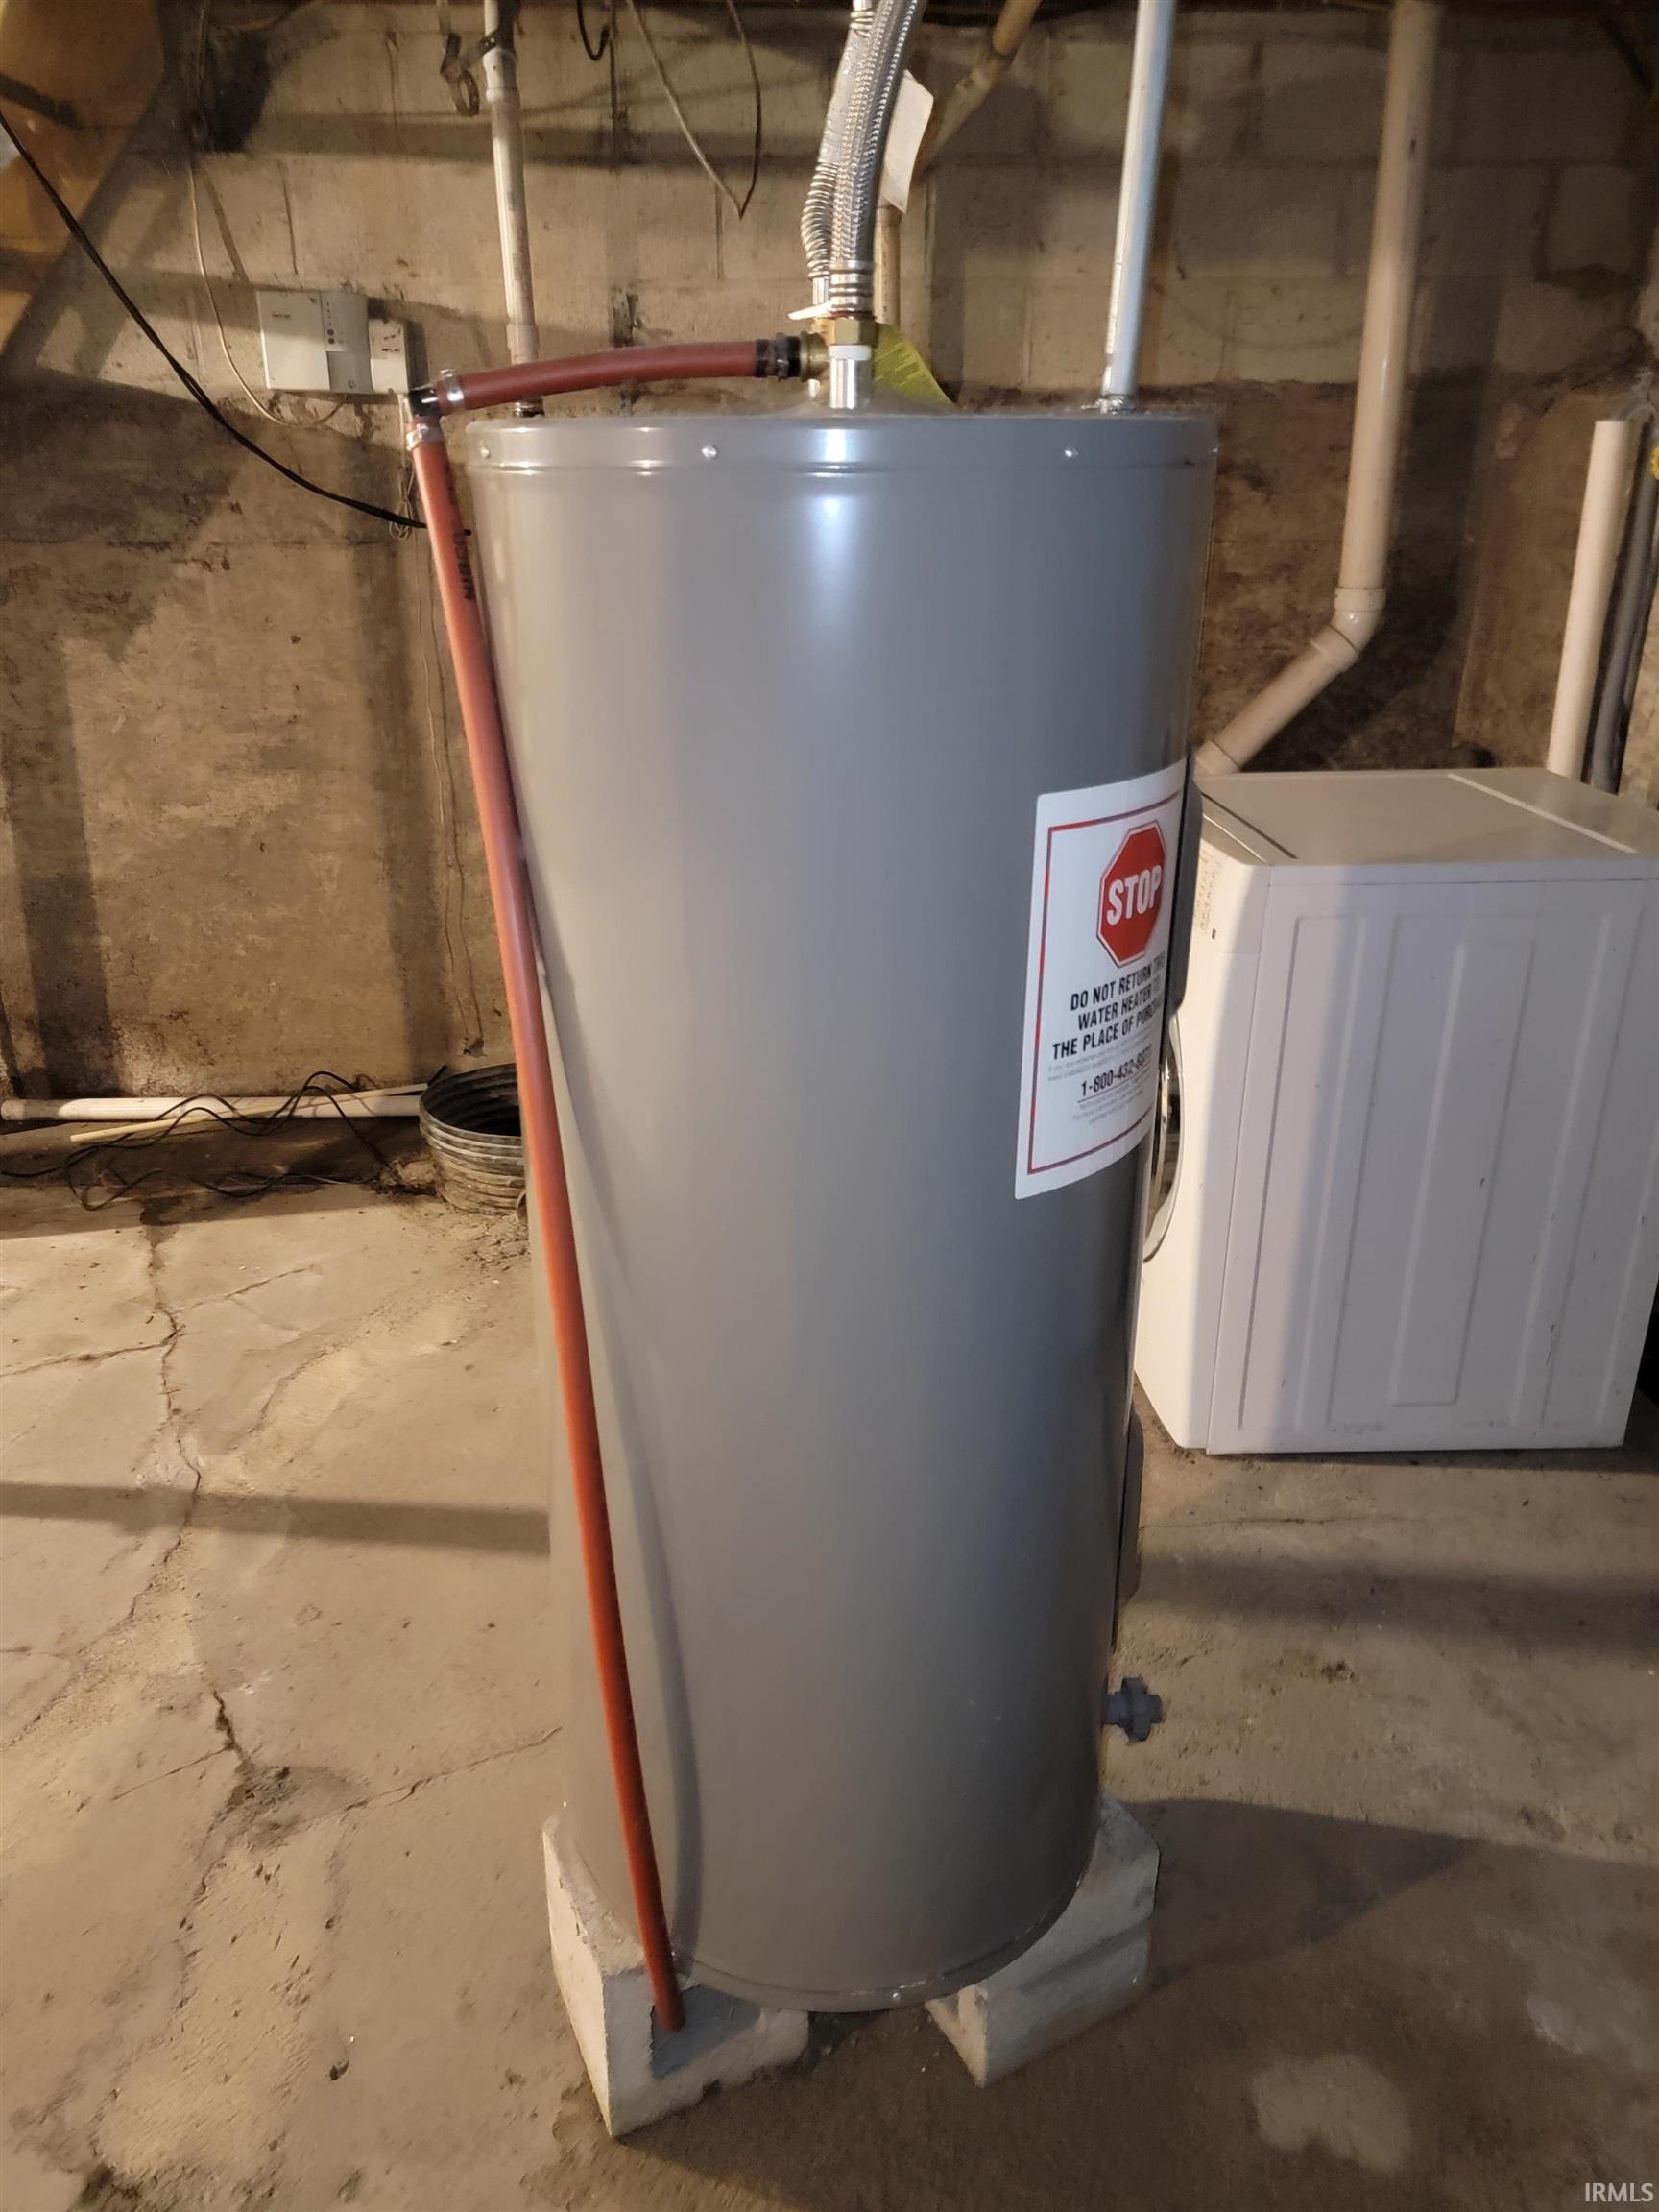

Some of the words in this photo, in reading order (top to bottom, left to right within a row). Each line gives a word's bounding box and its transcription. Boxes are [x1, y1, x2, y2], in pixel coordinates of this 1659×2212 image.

[1106, 864, 1162, 926] STOP
[1070, 990, 1089, 1011] DO
[1093, 980, 1117, 1005] NOT
[1118, 962, 1152, 995] RETURN
[1078, 1001, 1118, 1031] WATER
[1121, 983, 1152, 1016] HEATER
[1052, 1038, 1078, 1061] THE
[1083, 1023, 1119, 1052] PLACE
[1122, 1015, 1134, 1036] OF
